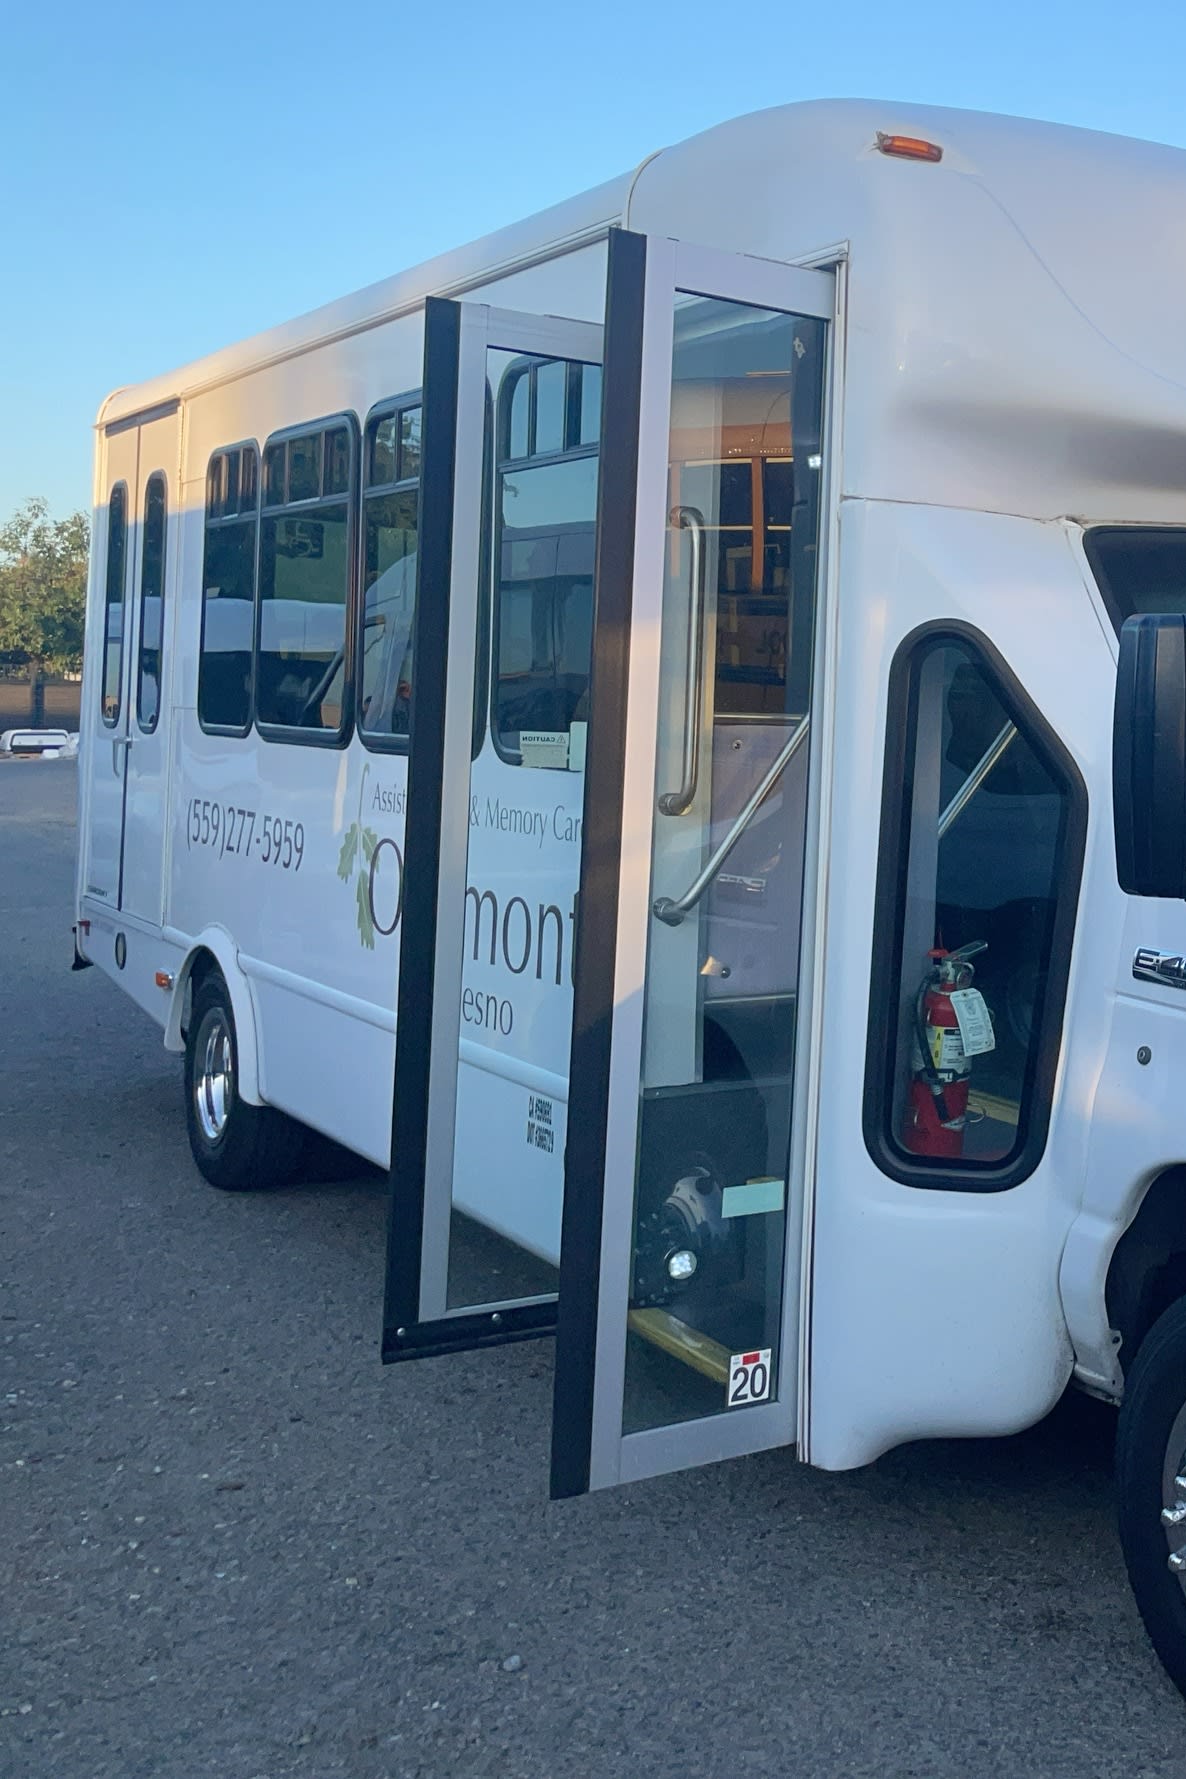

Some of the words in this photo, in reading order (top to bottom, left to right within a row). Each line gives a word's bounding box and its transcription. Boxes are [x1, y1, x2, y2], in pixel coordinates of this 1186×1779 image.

[186, 798, 305, 871] (559)277-5959
[372, 783, 407, 815] Assist
[485, 798, 548, 848] Memory
[553, 805, 582, 842] Car
[369, 838, 576, 986] Omon
[462, 987, 513, 1035] esno
[731, 1362, 767, 1402] 20
